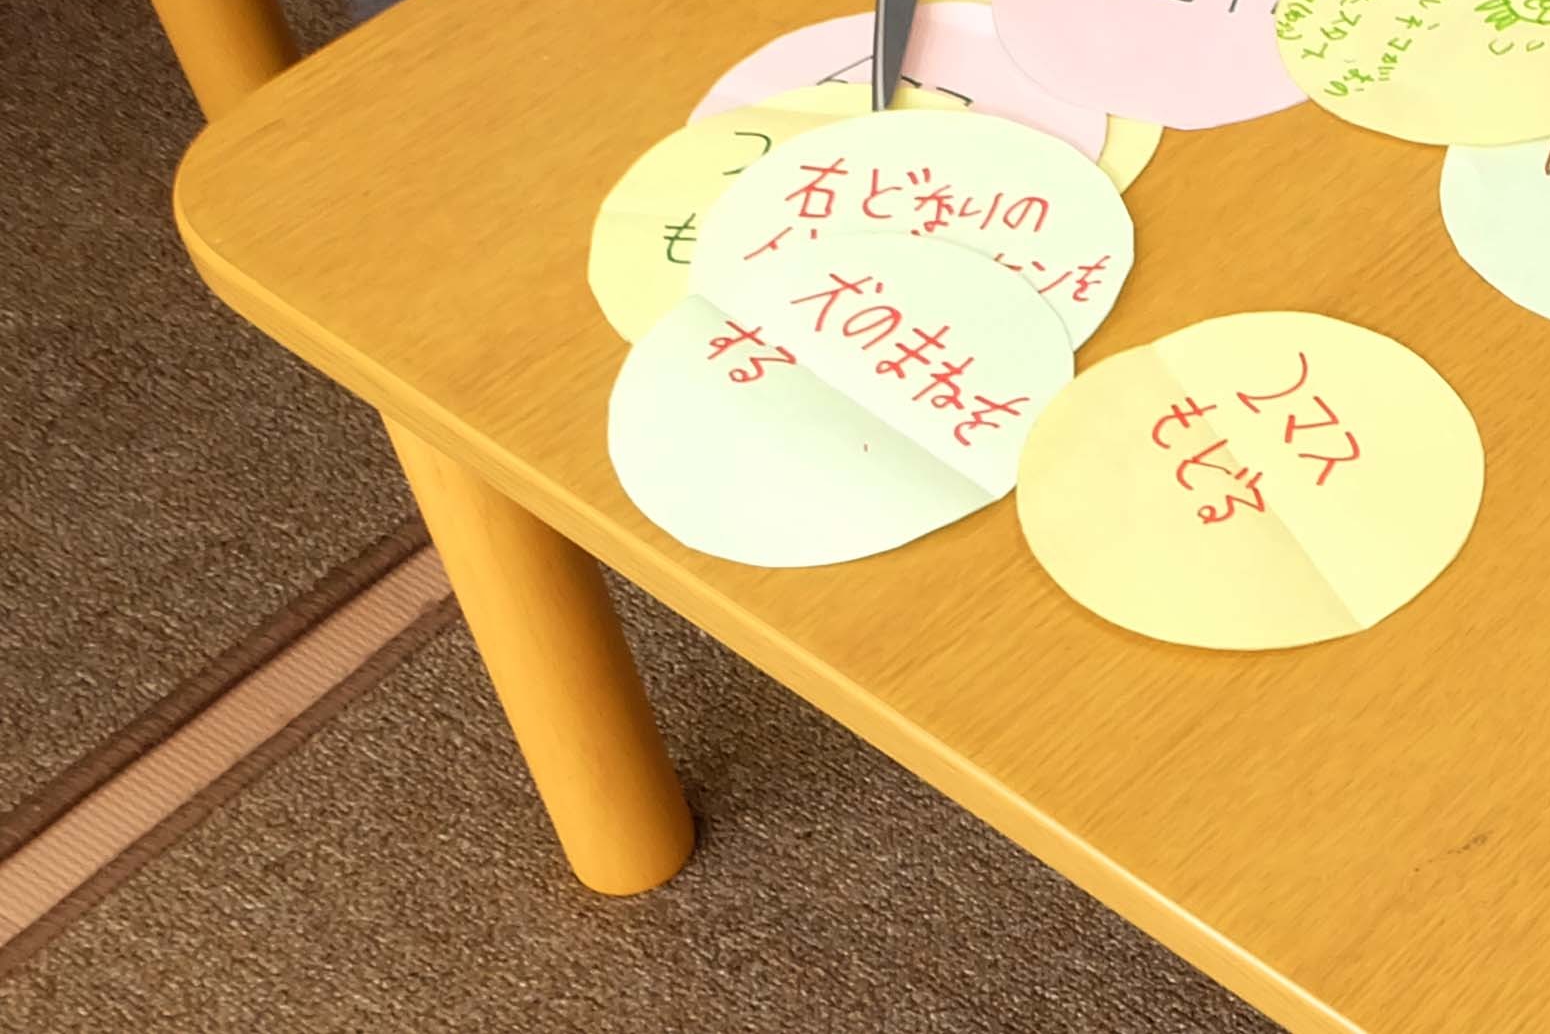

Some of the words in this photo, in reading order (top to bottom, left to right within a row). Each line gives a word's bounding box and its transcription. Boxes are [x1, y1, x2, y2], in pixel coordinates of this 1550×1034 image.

[706, 319, 798, 384] する
[790, 271, 1031, 447] 犬のまねを
[1151, 396, 1266, 524] もどる
[1235, 351, 1361, 487] 2マス
